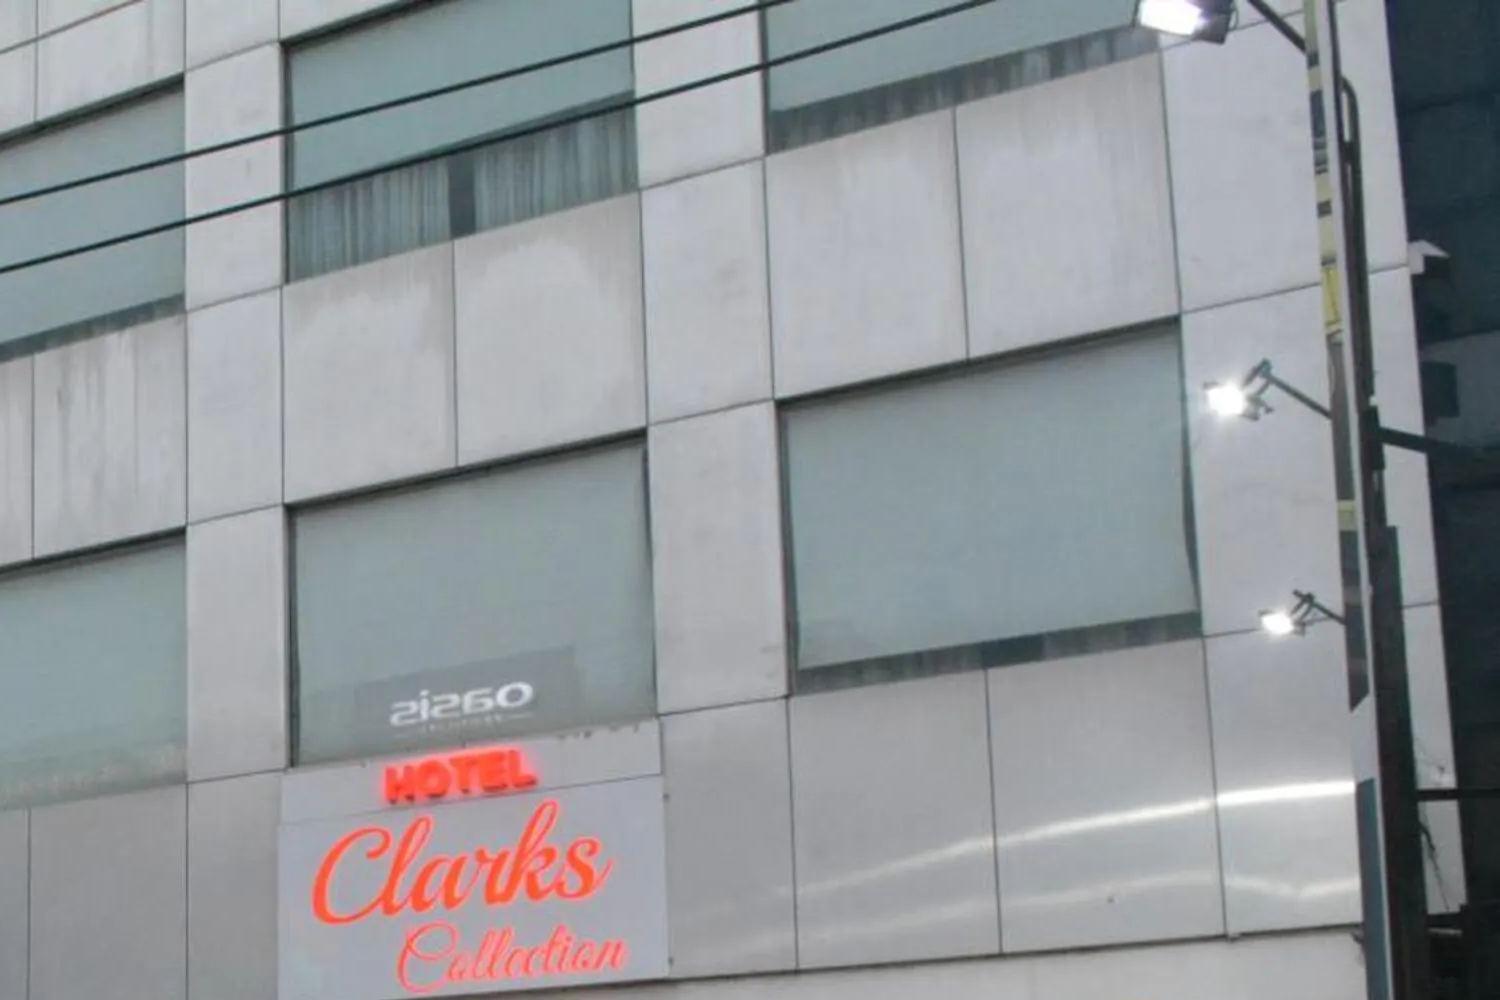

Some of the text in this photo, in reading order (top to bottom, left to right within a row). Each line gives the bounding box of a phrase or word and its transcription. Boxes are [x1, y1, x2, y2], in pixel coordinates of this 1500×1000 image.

[382, 746, 538, 804] HOTEL
[311, 799, 614, 926] Clarks
[397, 920, 628, 993] Collection
